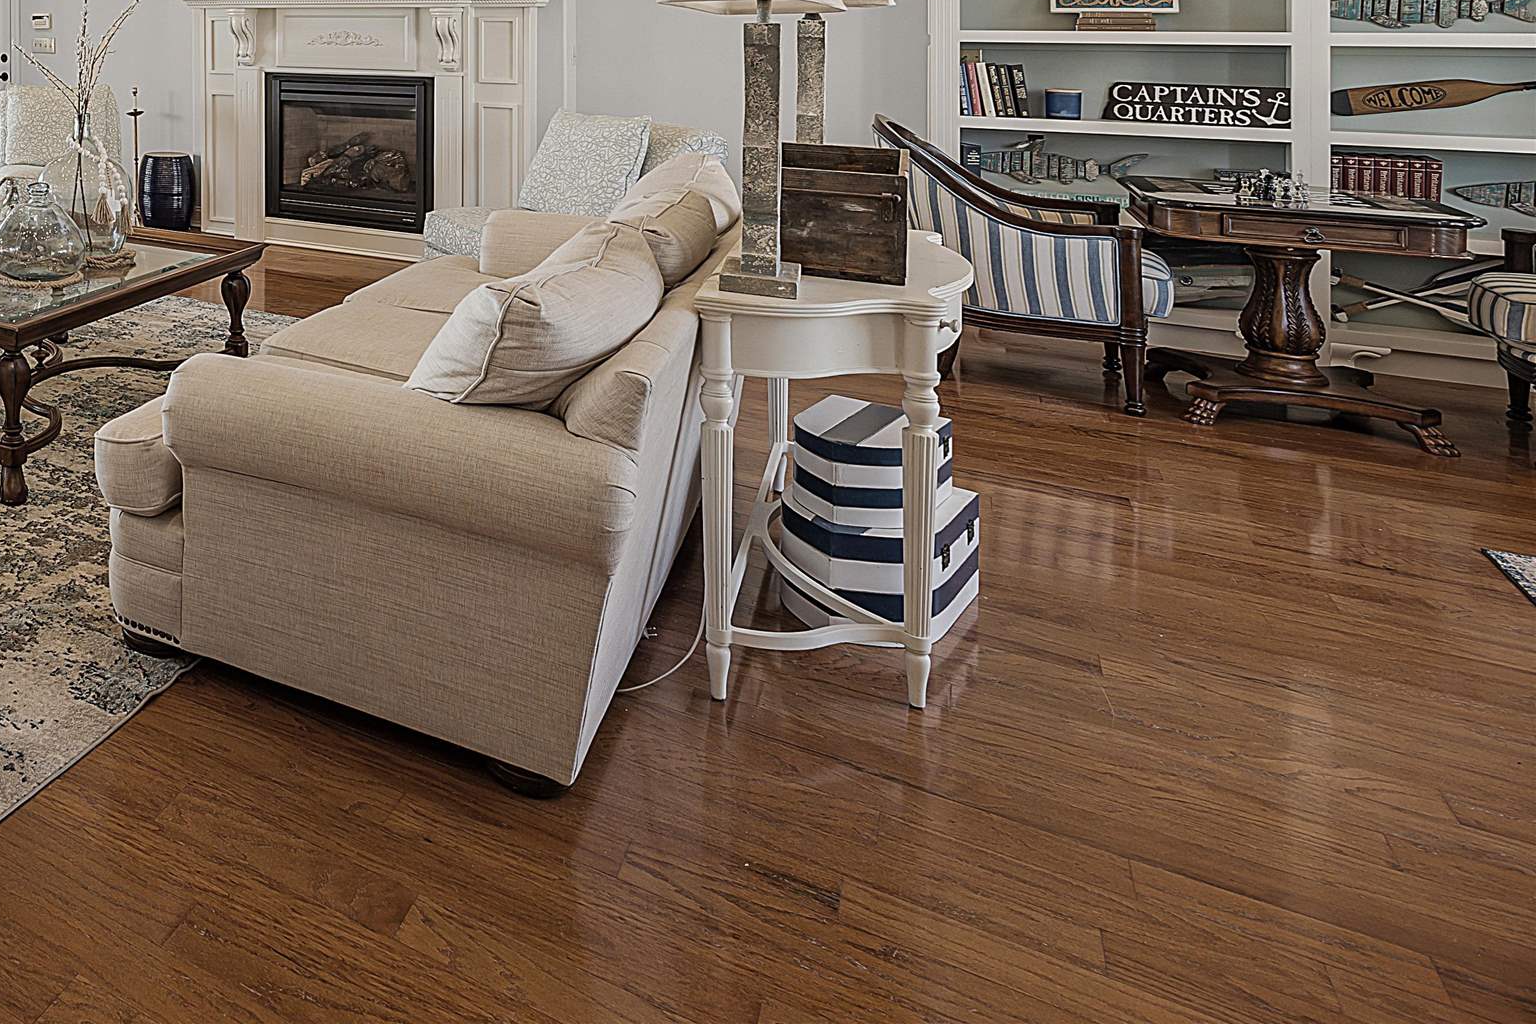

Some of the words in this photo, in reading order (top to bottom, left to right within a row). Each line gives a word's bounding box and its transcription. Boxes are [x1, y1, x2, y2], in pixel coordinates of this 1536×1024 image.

[1113, 84, 1261, 107] CAPTAIN'S
[1366, 86, 1443, 107] WELCOME
[1114, 103, 1252, 126] QUARTERS
